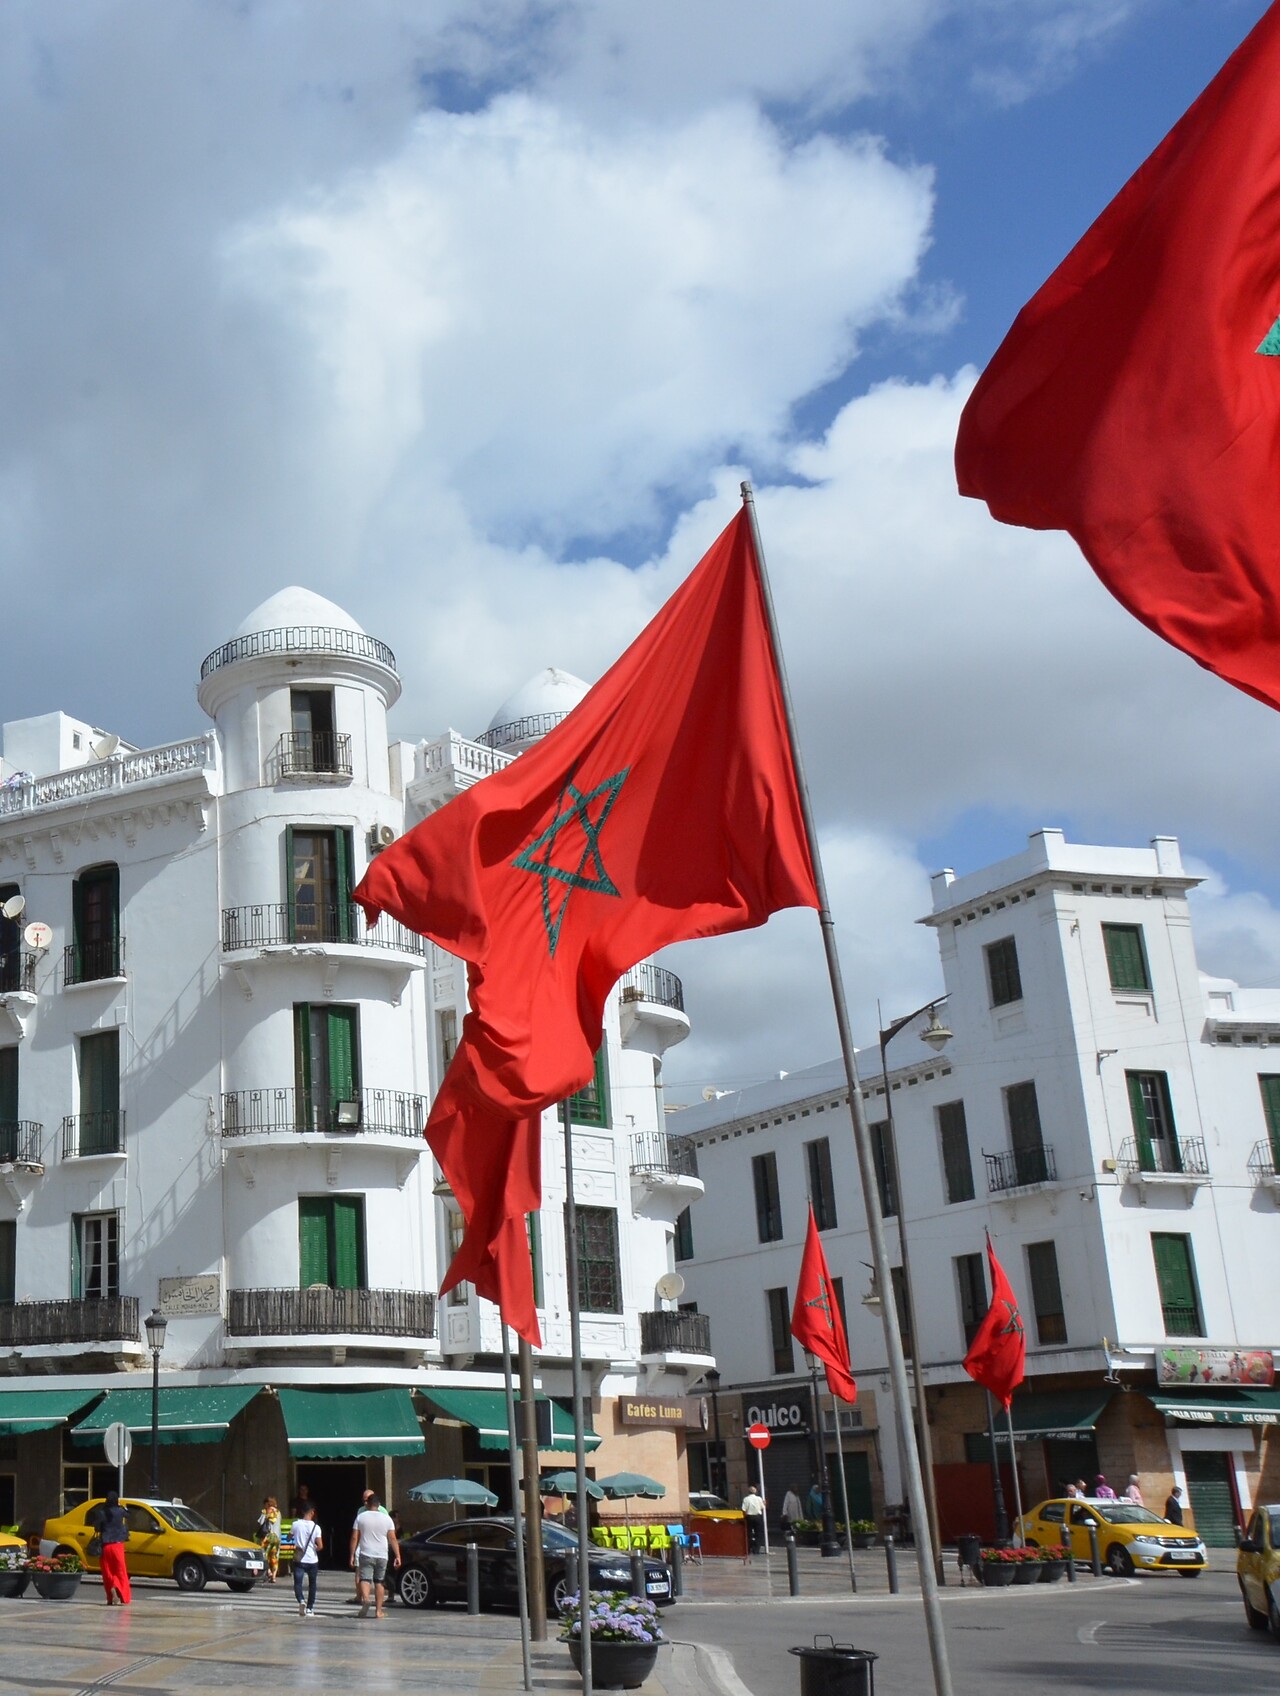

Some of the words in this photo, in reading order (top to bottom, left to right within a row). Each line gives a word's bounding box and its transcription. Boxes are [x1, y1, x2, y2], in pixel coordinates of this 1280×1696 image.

[627, 1403, 657, 1417] Cafés
[660, 1405, 682, 1418] Luna
[748, 1403, 800, 1427] Quico
[1241, 1413, 1254, 1422] ICE
